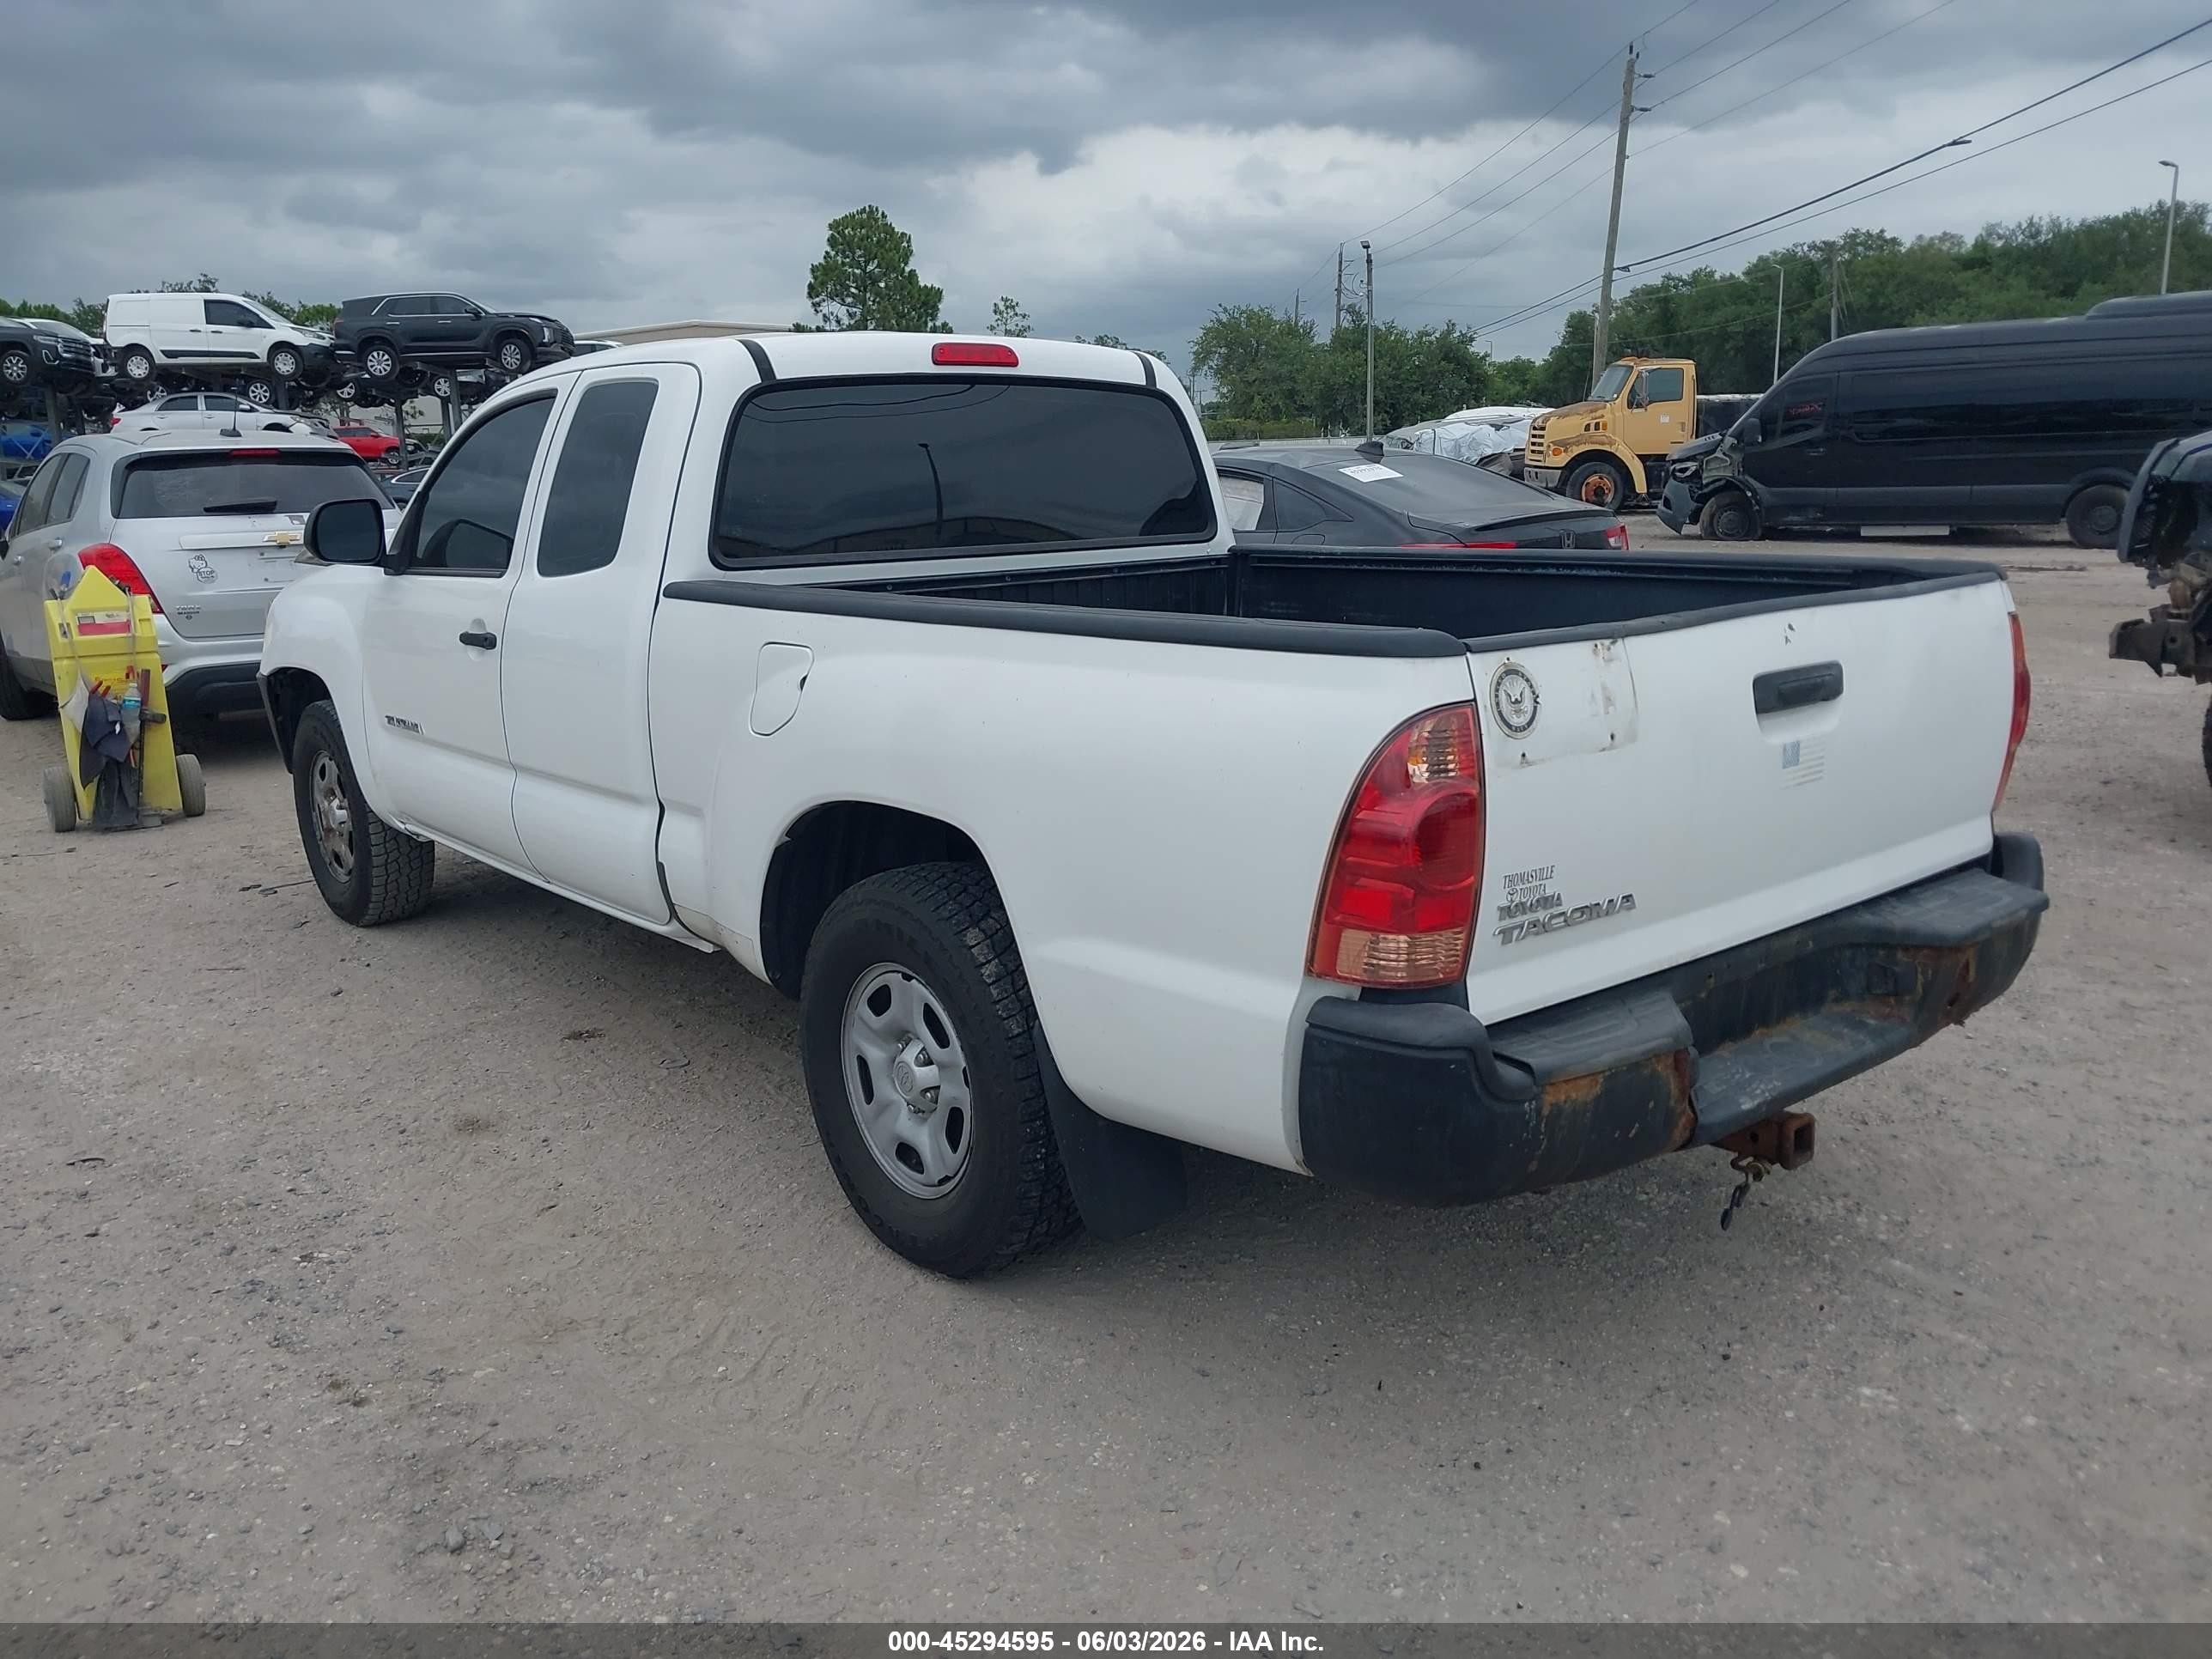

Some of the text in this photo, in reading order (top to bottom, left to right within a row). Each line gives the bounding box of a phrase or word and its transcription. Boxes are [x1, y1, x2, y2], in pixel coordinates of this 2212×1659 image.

[1503, 865, 1555, 890] THOMASVILLE
[1518, 883, 1547, 900] TOYOTA
[1492, 892, 1637, 945] TACOMA
[1497, 891, 1563, 921] TOYOTA
